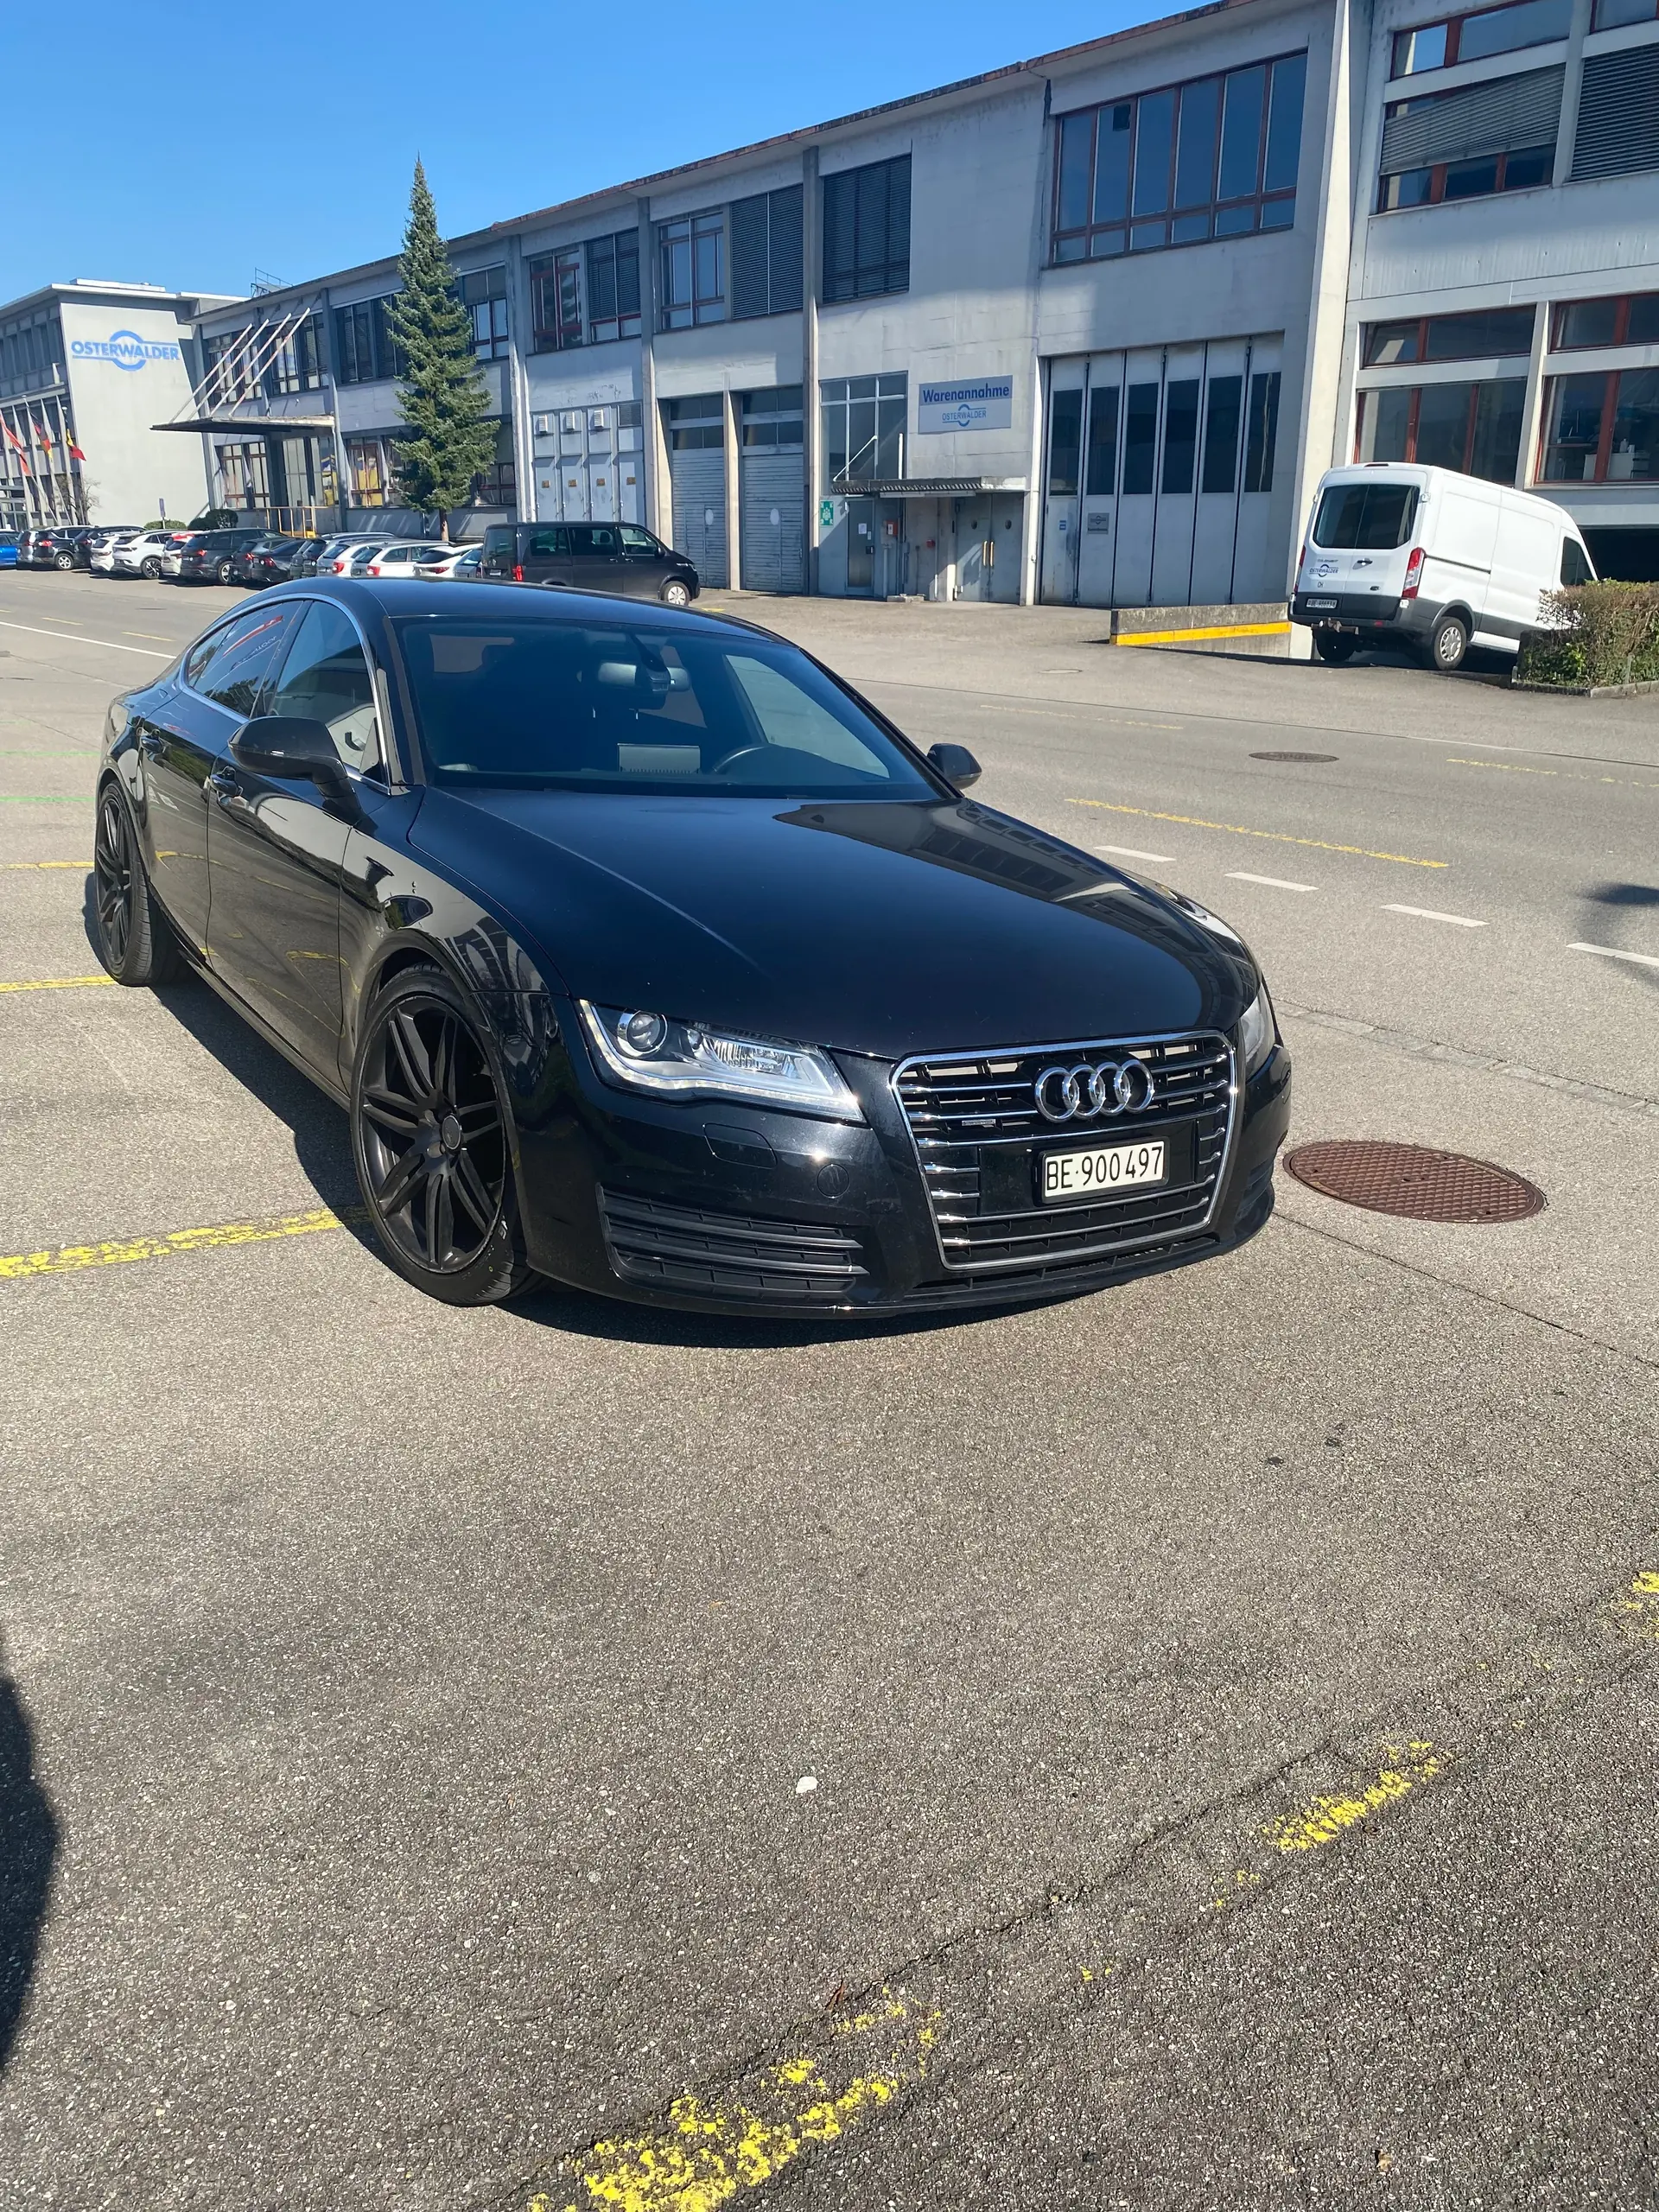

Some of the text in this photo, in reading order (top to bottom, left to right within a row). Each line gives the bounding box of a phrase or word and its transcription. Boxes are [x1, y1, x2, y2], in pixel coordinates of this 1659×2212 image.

[71, 340, 180, 360] OSTERWALDER
[923, 383, 1009, 403] Warenannahme
[942, 410, 987, 421] OSTERWALDER
